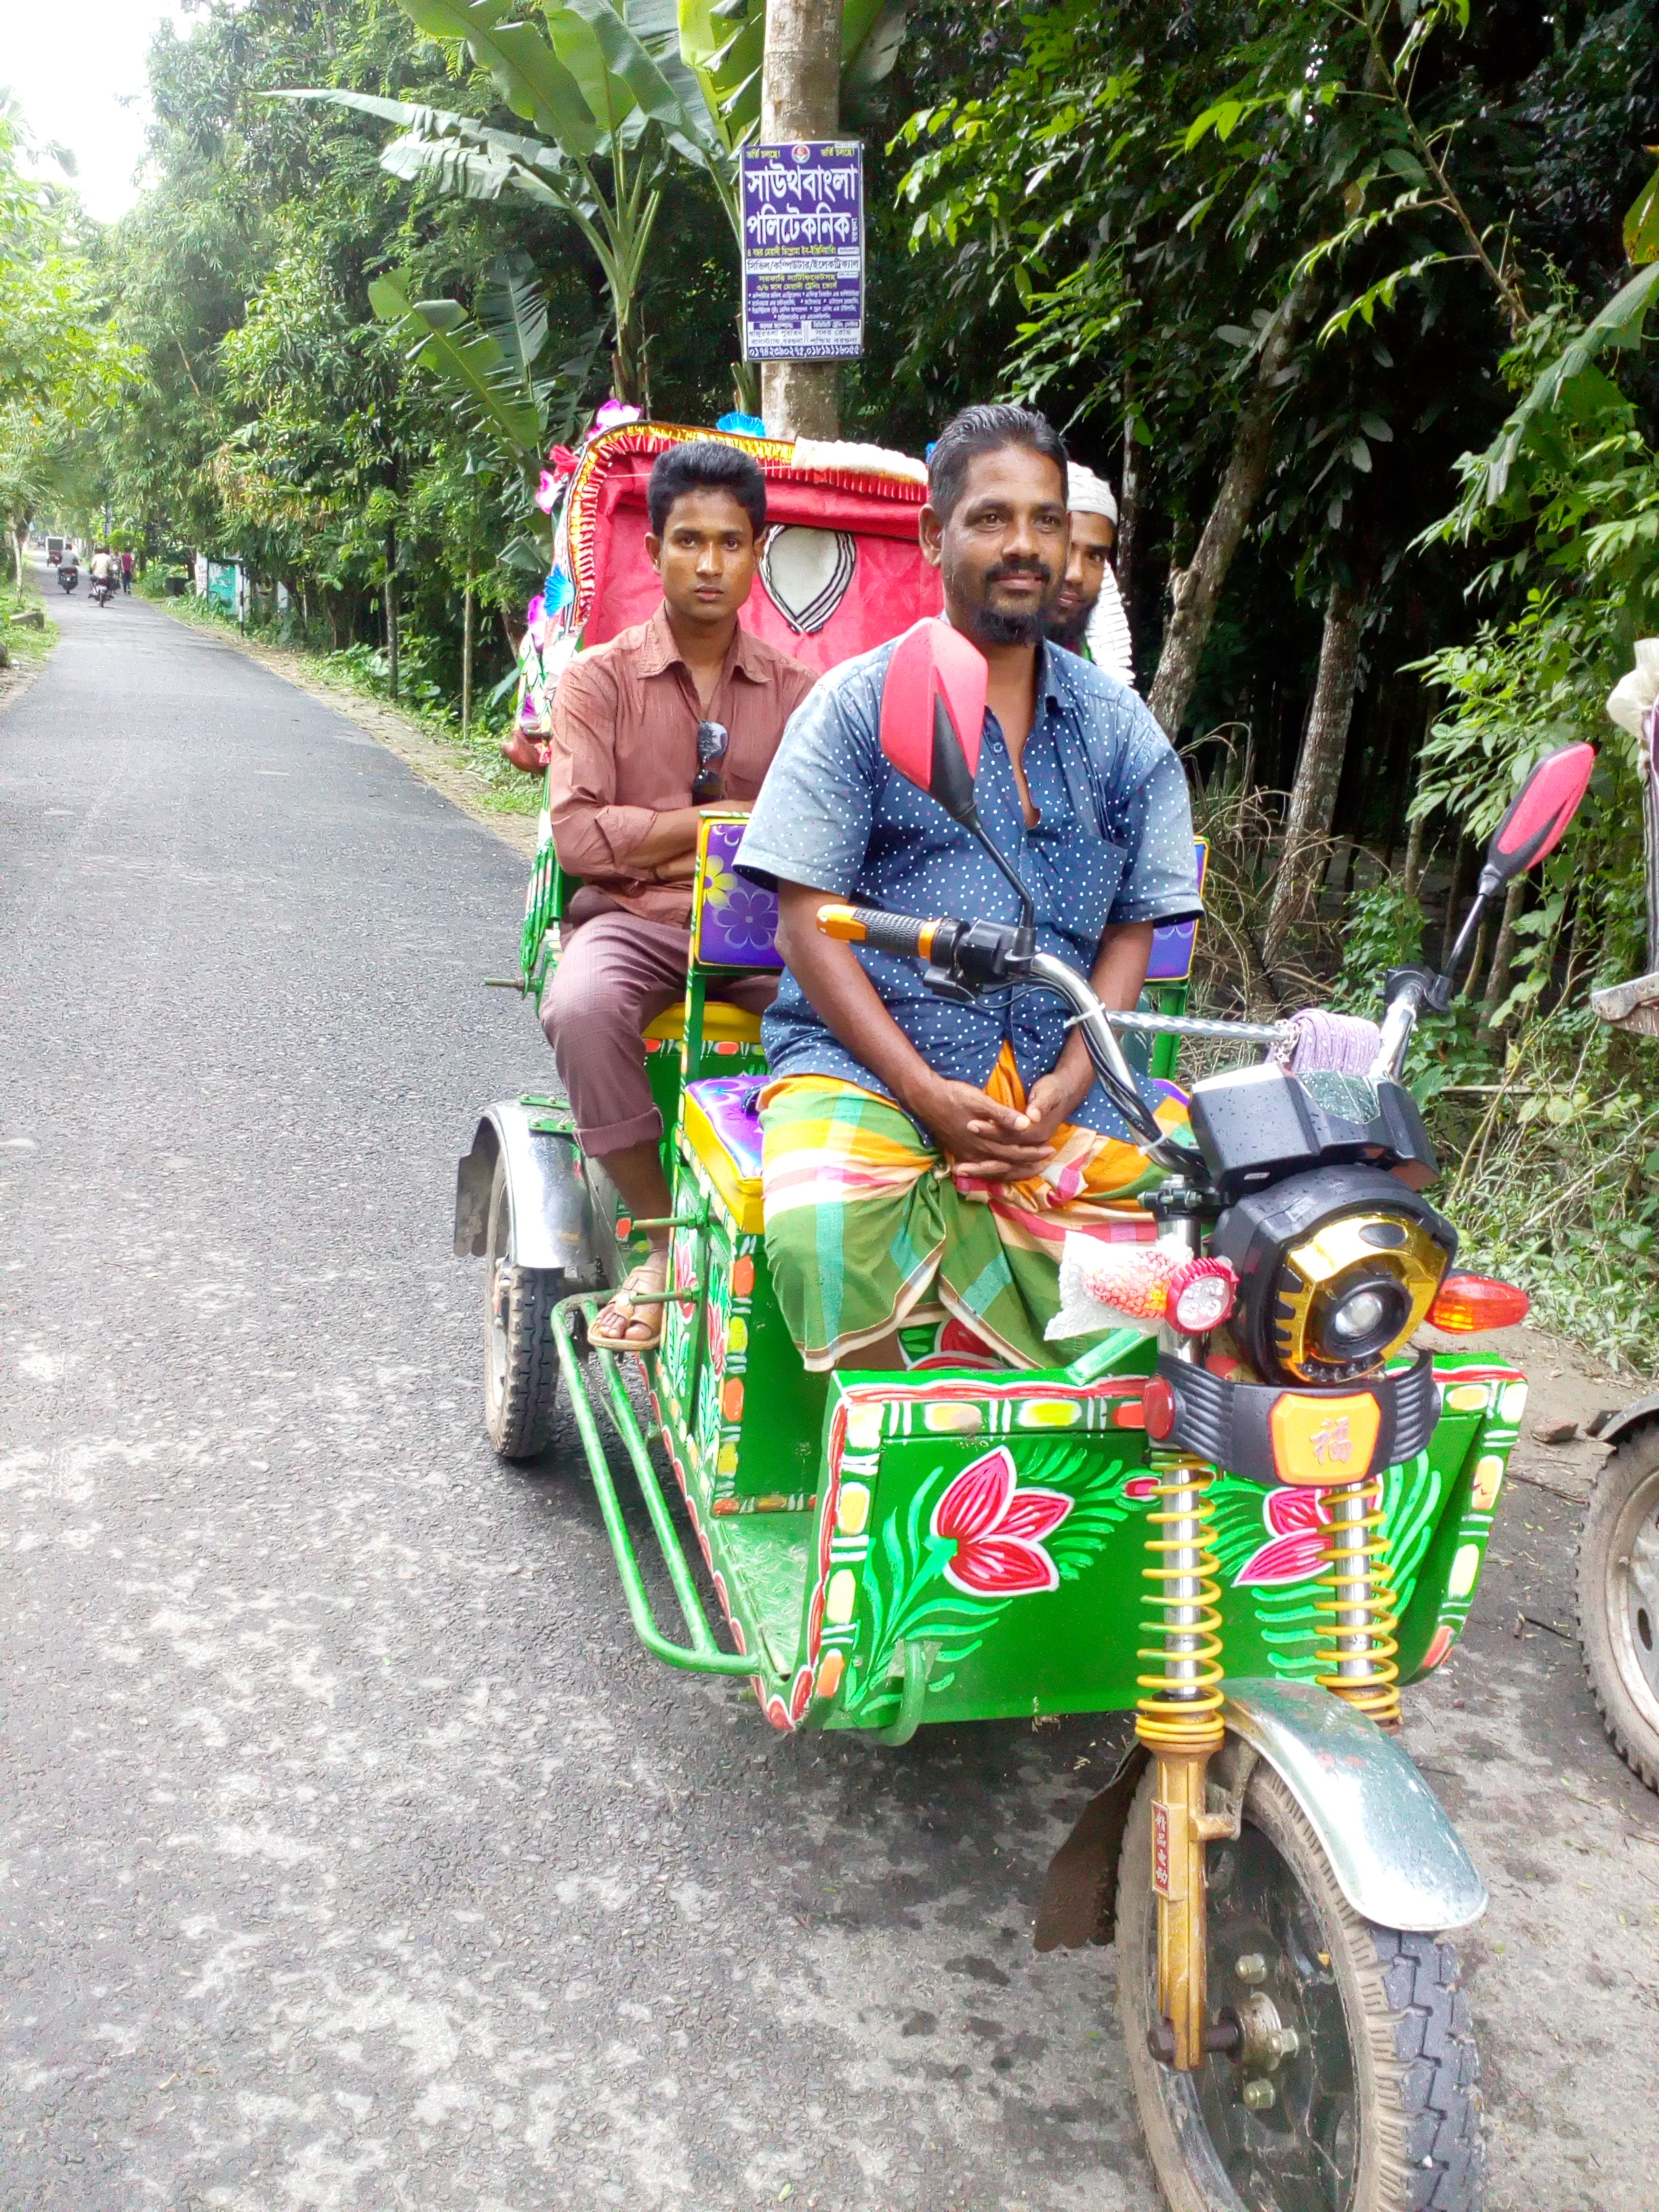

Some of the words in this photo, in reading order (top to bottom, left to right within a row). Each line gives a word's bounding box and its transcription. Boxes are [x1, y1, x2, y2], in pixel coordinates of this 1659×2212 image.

[745, 159, 858, 203] সাউথবাংলা
[747, 202, 852, 245] পলিটেকনিক
[1310, 1416, 1353, 1465] 福
